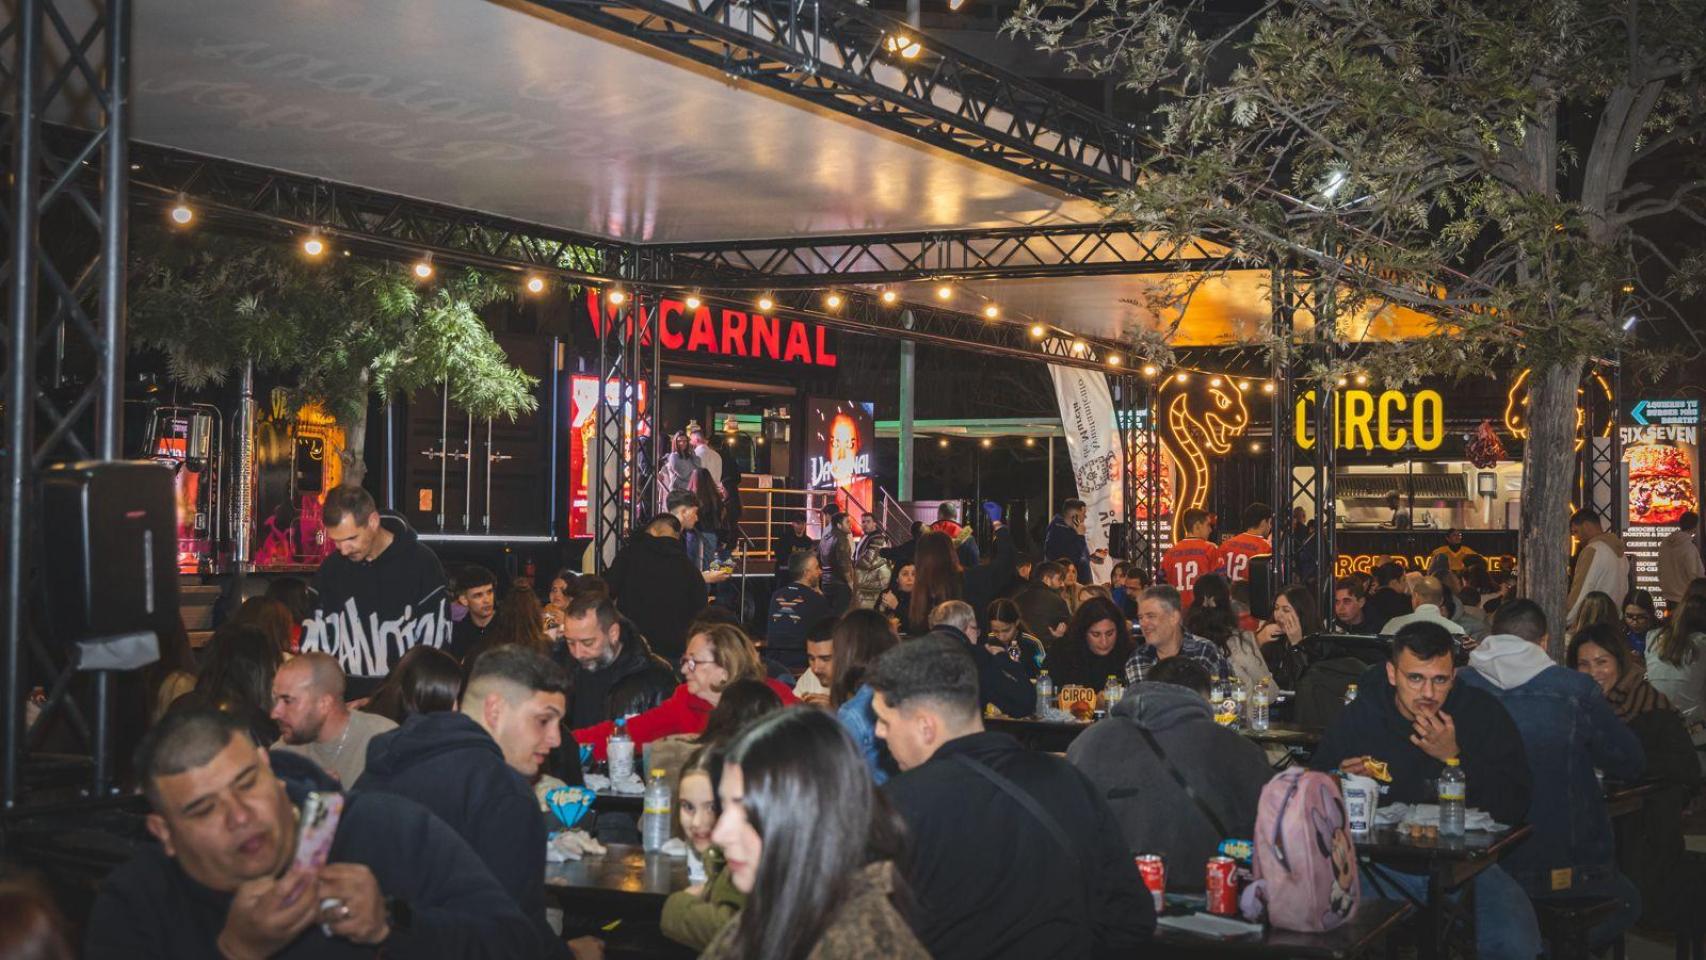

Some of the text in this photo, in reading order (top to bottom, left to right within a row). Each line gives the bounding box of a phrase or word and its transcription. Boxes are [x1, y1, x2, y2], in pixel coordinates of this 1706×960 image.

[1620, 426, 1697, 445] SIX SEVEN
[1175, 561, 1199, 591] 12
[1227, 552, 1248, 581] 12
[1063, 689, 1093, 701] CIRCO
